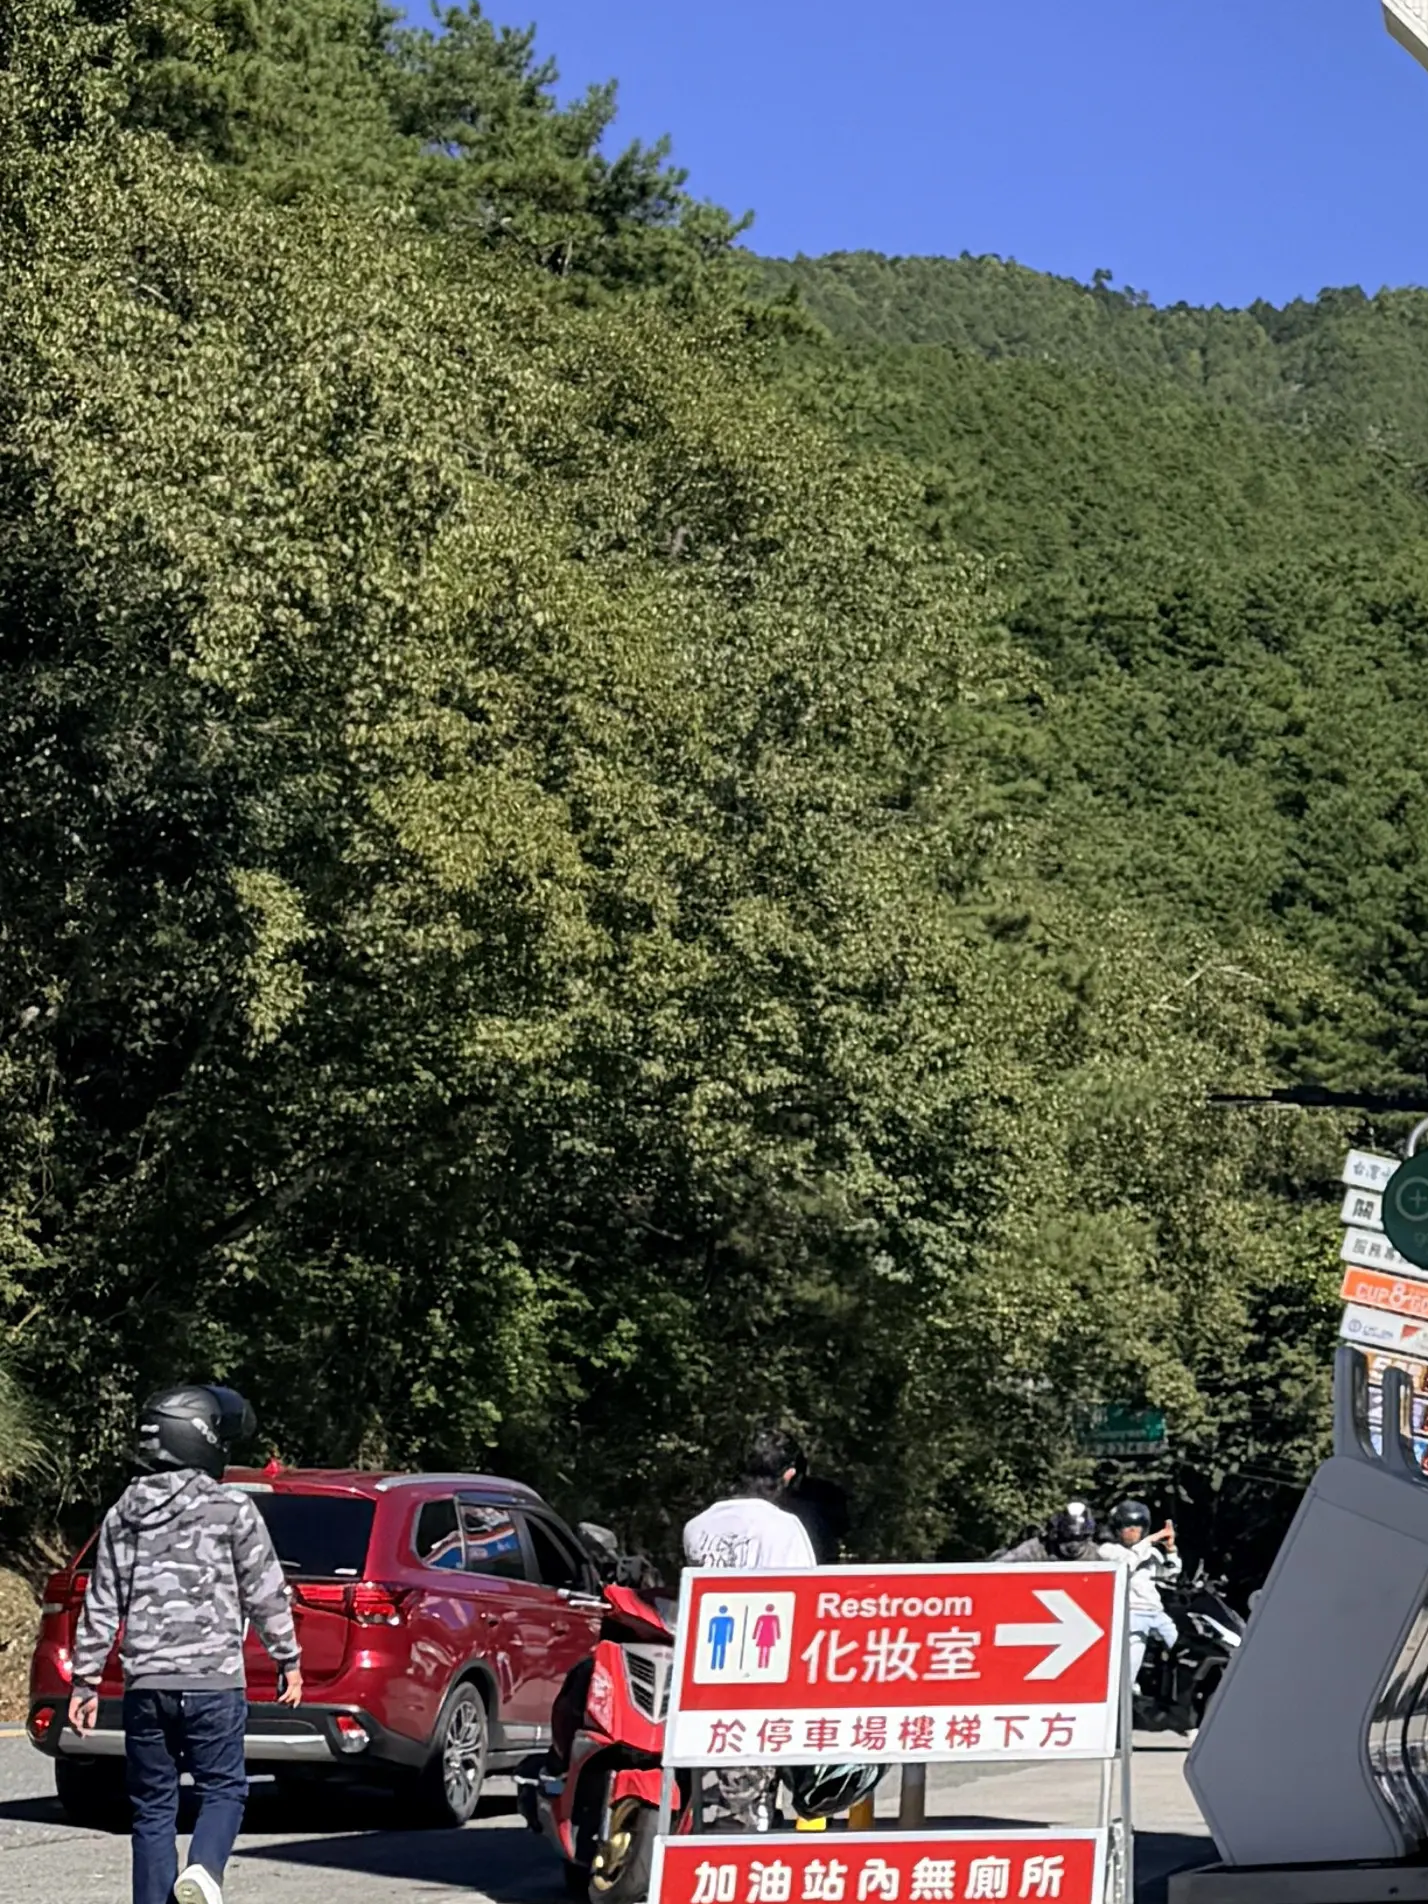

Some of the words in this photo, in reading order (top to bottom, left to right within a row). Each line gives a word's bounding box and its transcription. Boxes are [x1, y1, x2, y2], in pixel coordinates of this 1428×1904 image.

[817, 1592, 974, 1620] Restroom
[800, 1627, 982, 1685] 化妝室
[707, 1712, 1078, 1755] 於停車場樓梯下方
[691, 1853, 1067, 1904] 加油站內無廁所
